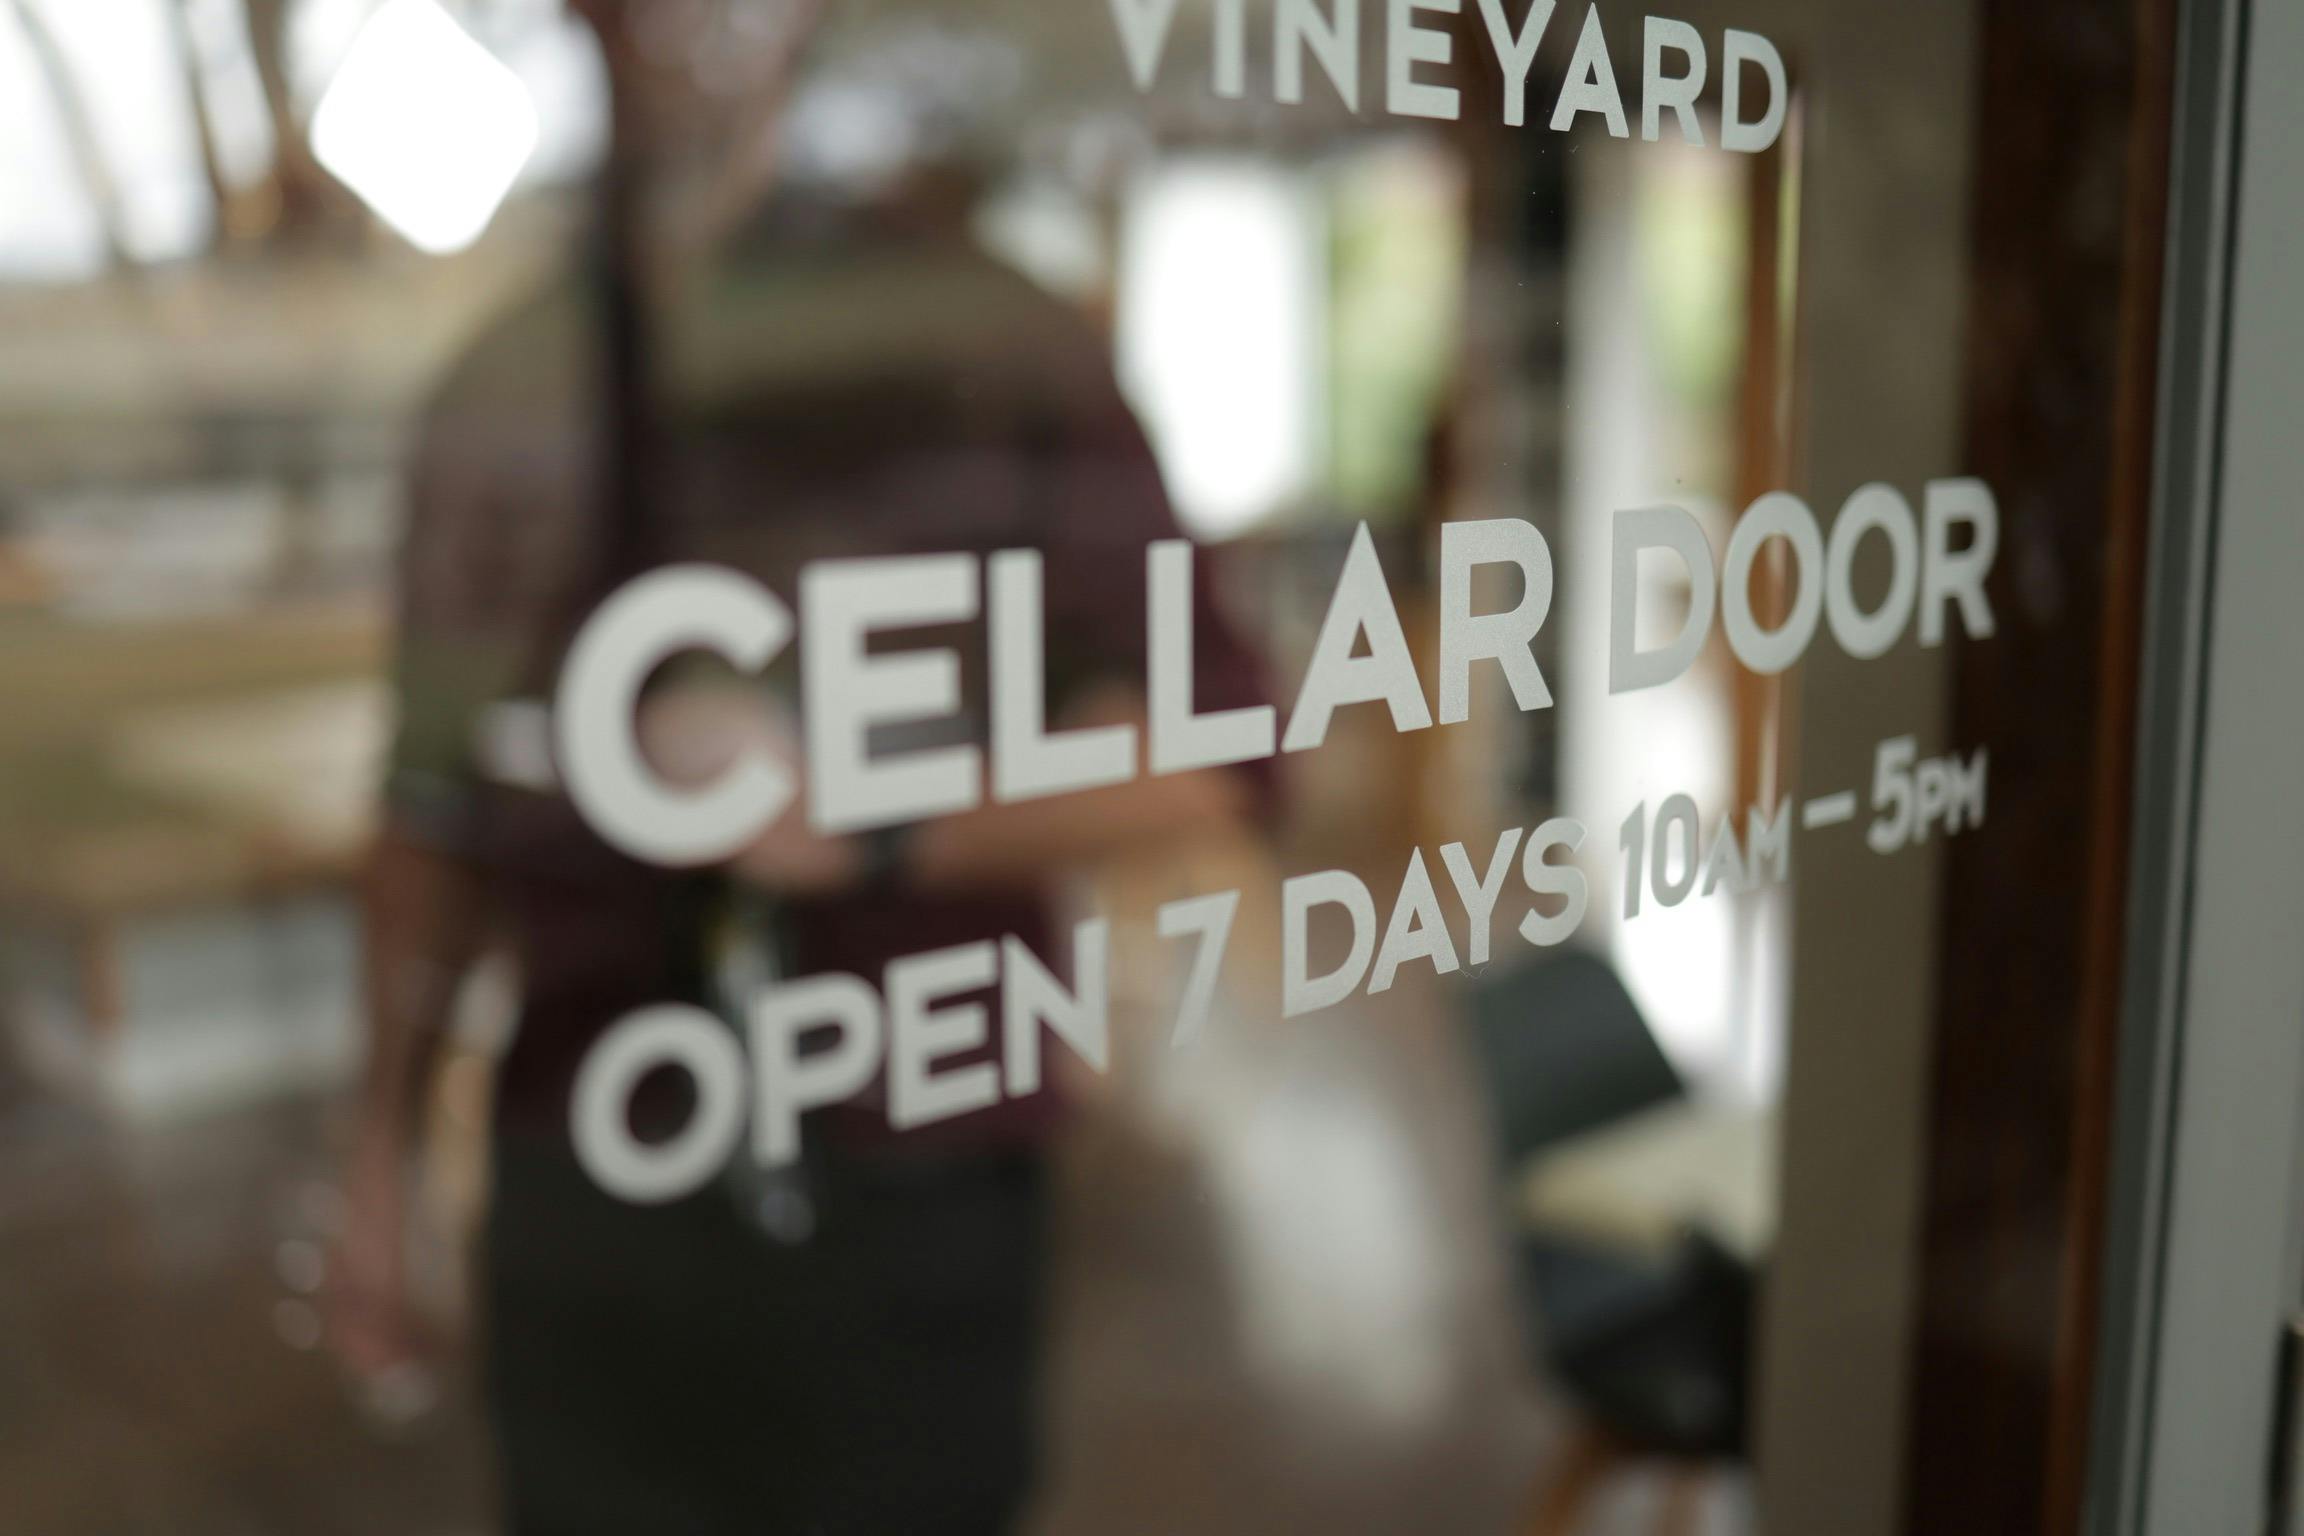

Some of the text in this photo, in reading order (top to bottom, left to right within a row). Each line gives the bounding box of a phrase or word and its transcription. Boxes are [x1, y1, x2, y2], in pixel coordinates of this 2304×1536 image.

[1103, 0, 1789, 153] VINEYARD
[554, 477, 1998, 869] CELLAR DOOR
[570, 916, 1110, 1204] OPEN
[1157, 888, 1241, 1052] 7
[1282, 817, 1589, 1018] DAYS
[1618, 792, 1793, 920] 10AM
[1866, 734, 1988, 855] 5PM
